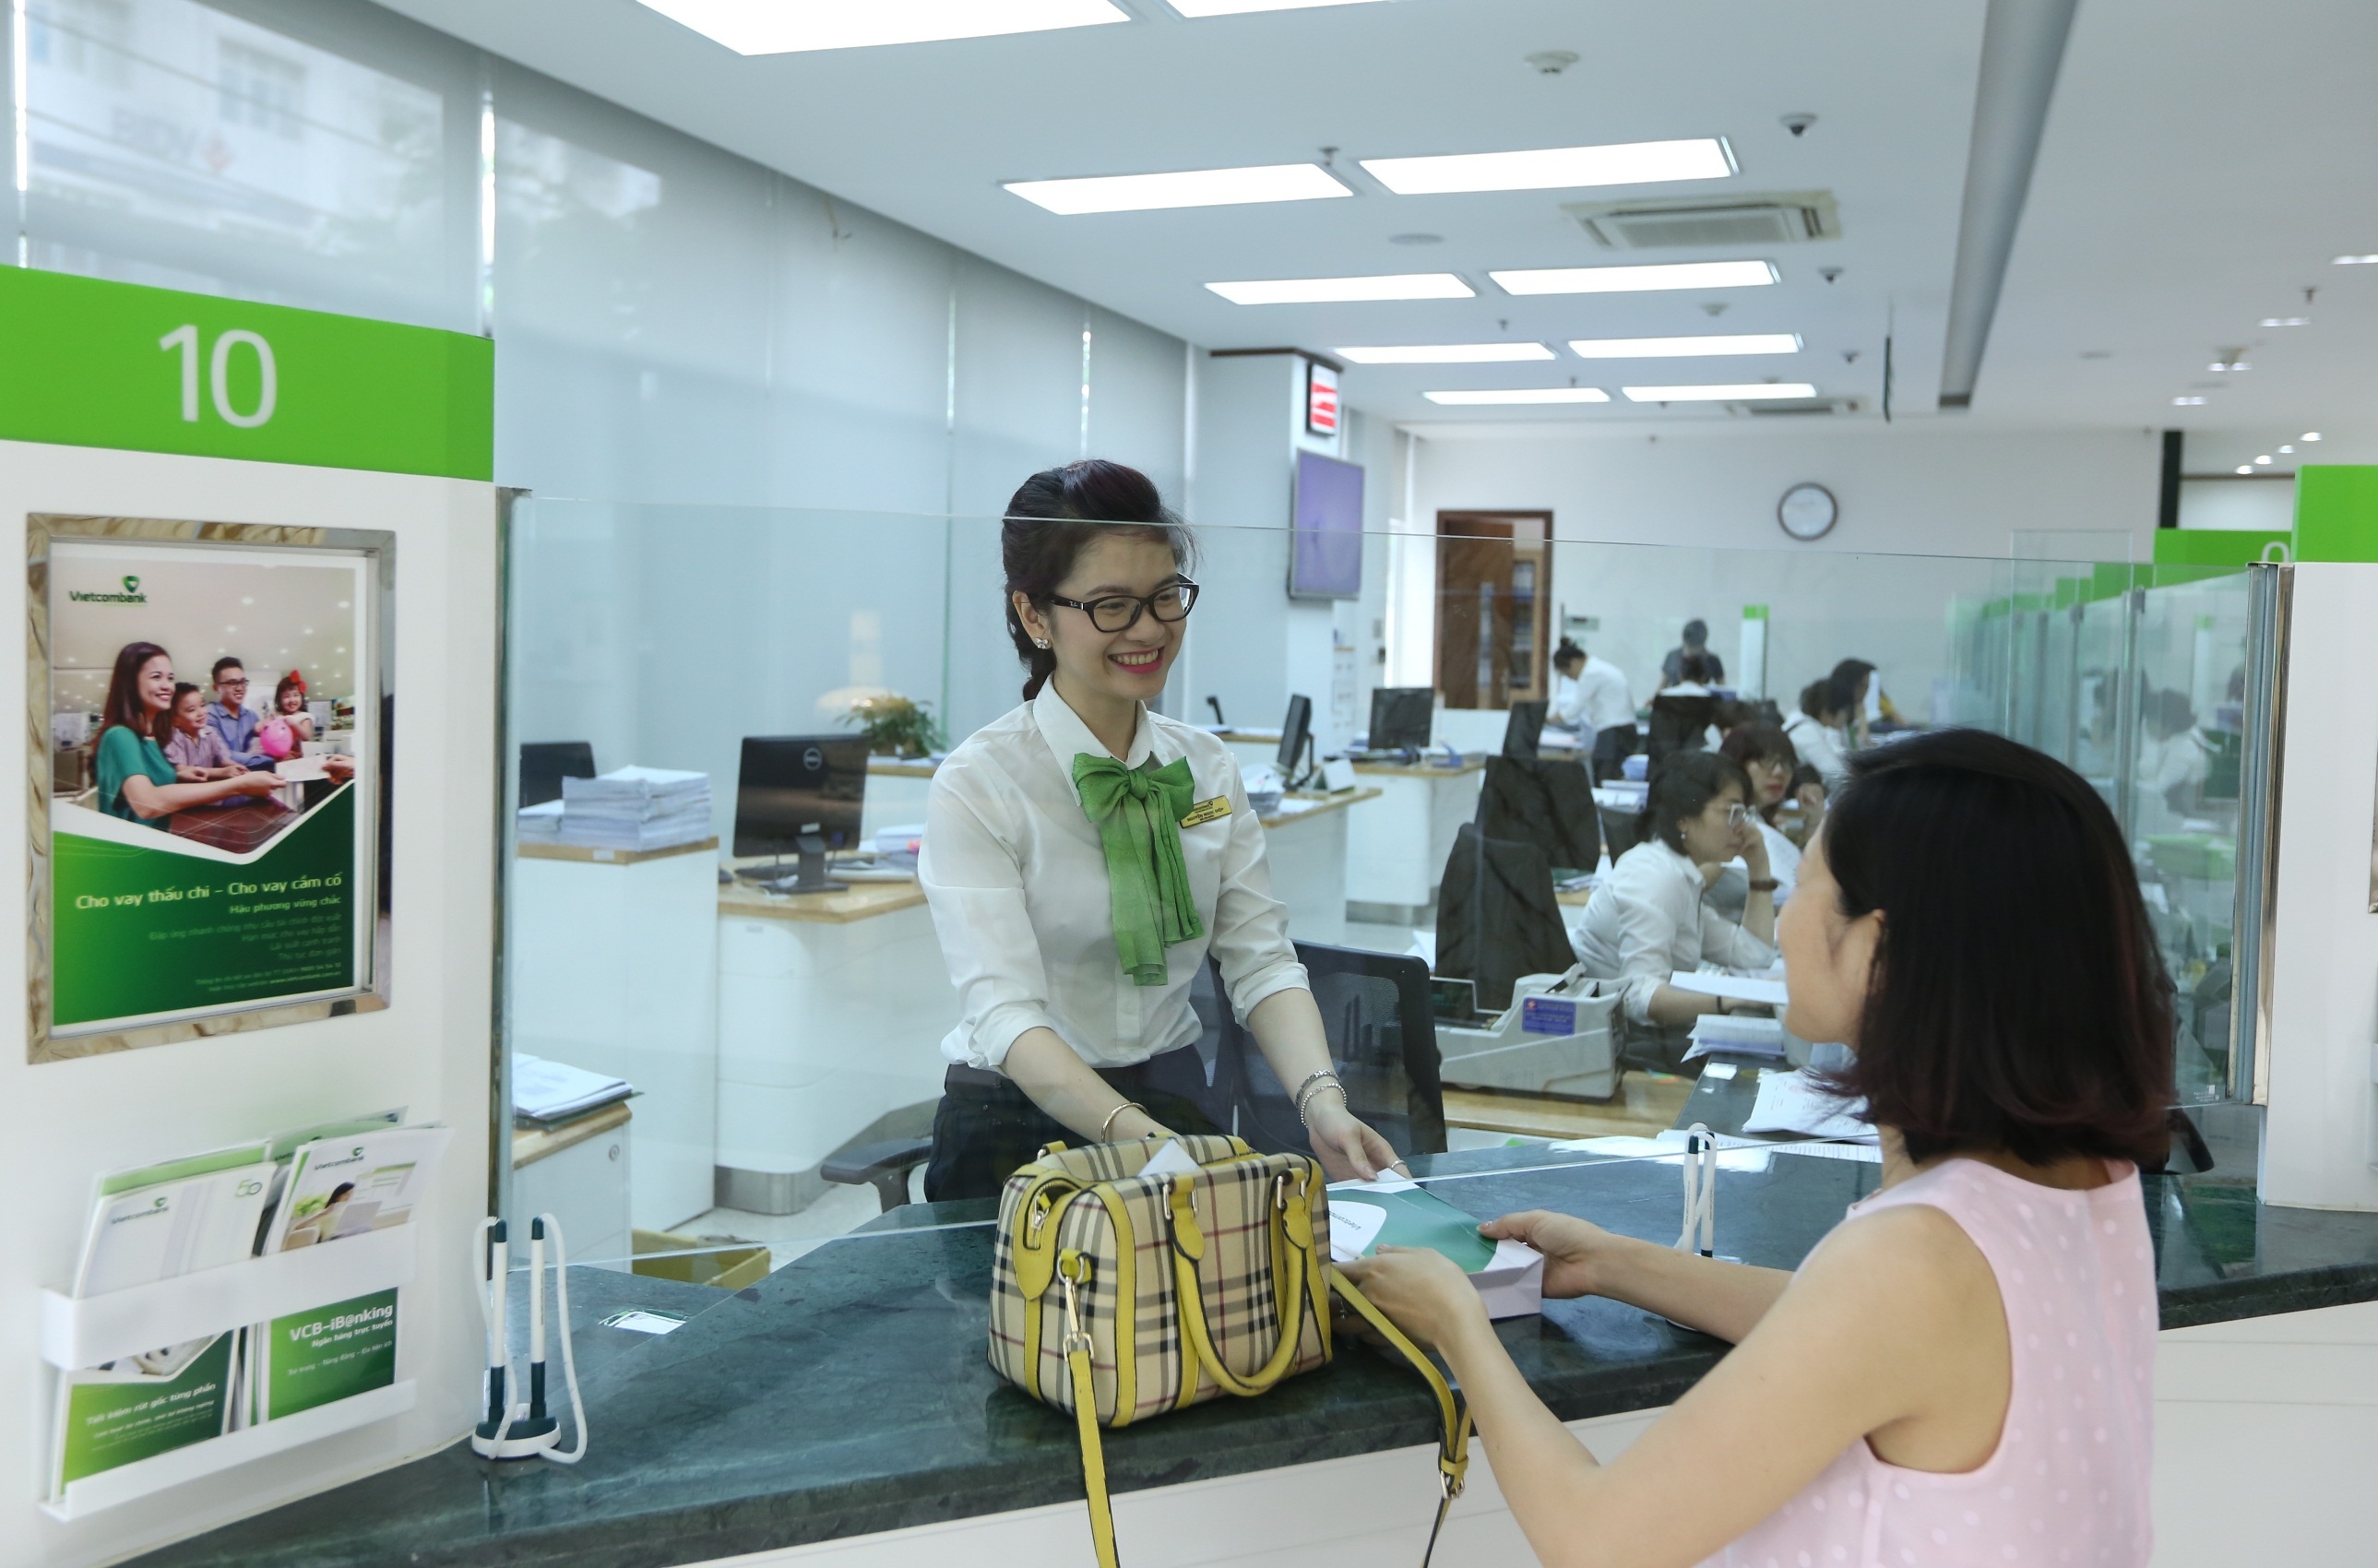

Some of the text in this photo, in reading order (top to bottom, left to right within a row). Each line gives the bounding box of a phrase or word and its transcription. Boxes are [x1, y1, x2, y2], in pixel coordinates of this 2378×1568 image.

[158, 324, 278, 428] 10
[69, 591, 147, 602] Vietcombank
[76, 894, 109, 909] Cho
[114, 896, 143, 908] vay
[149, 885, 184, 903] thấu
[187, 885, 210, 899] chi
[228, 882, 260, 896] Cho
[263, 881, 288, 893] vay
[325, 872, 344, 886] cố
[315, 1155, 364, 1170] Vietcombank
[111, 1206, 170, 1224] Vietcombank
